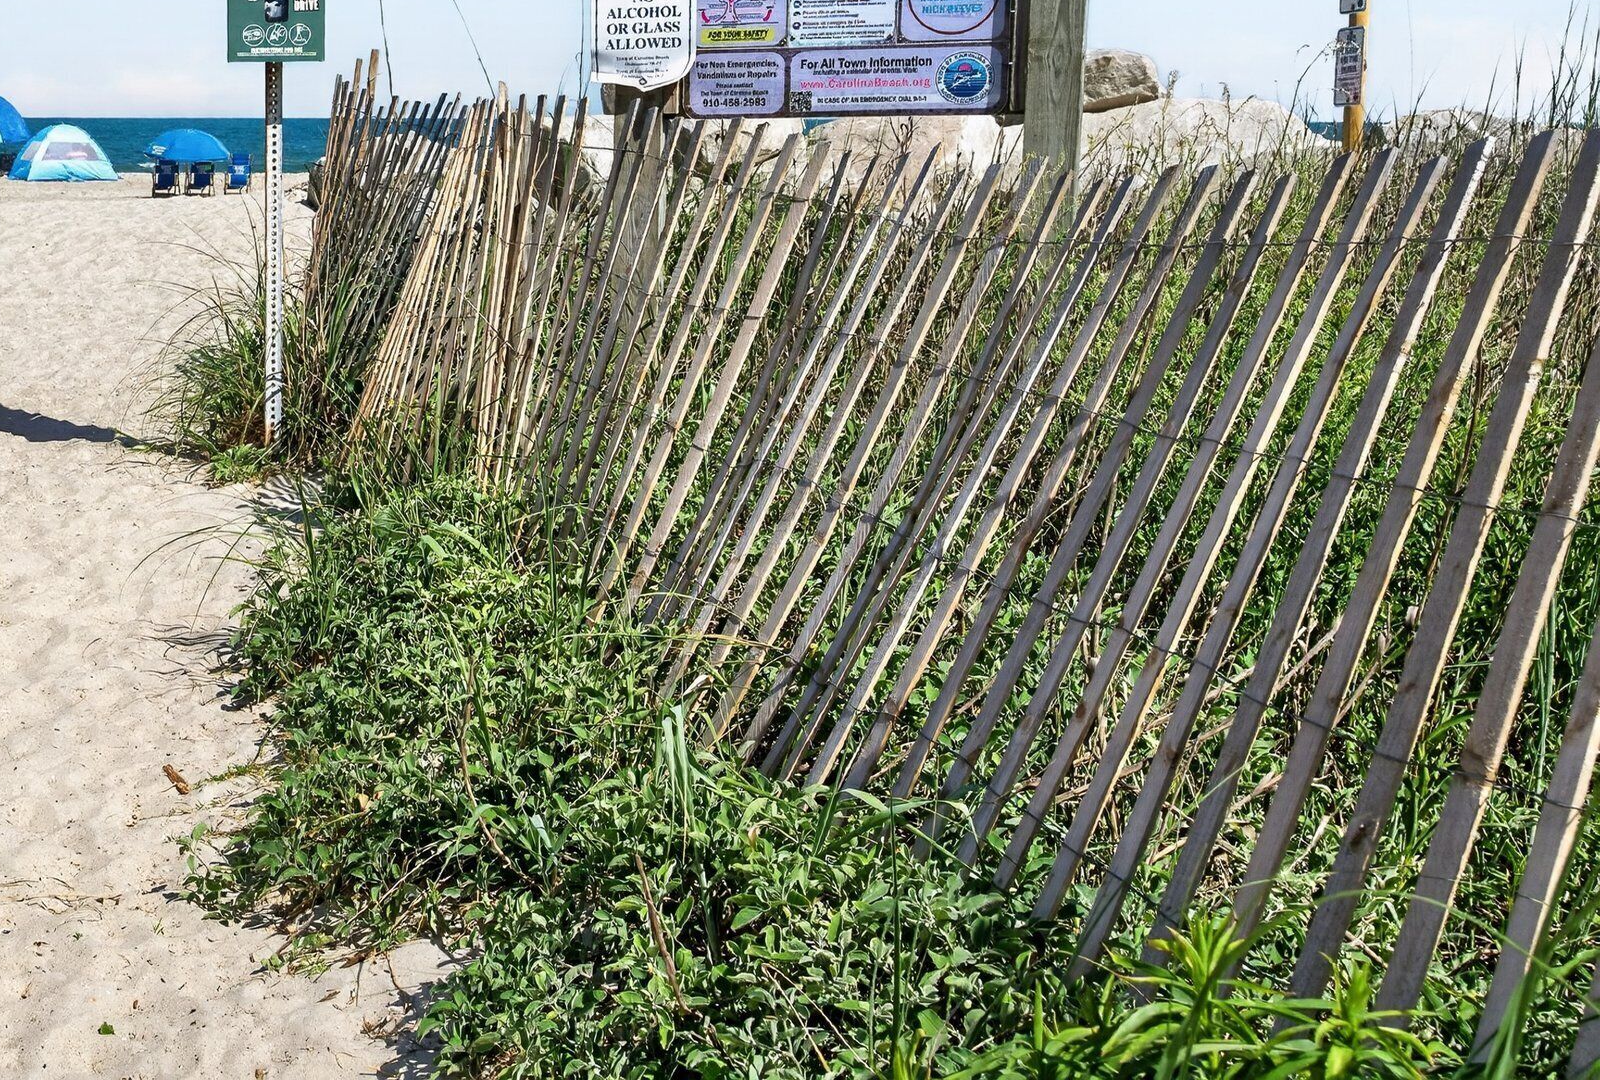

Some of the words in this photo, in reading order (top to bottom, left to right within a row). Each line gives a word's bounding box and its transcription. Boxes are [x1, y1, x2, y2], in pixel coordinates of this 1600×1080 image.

[607, 5, 681, 19] ALCOHOL
[606, 23, 628, 35] OR
[632, 21, 680, 34] GLASS
[605, 37, 681, 50] ALLOWED
[800, 60, 819, 69] For
[820, 59, 835, 68] All
[840, 58, 866, 68] Town
[870, 56, 932, 67] Information
